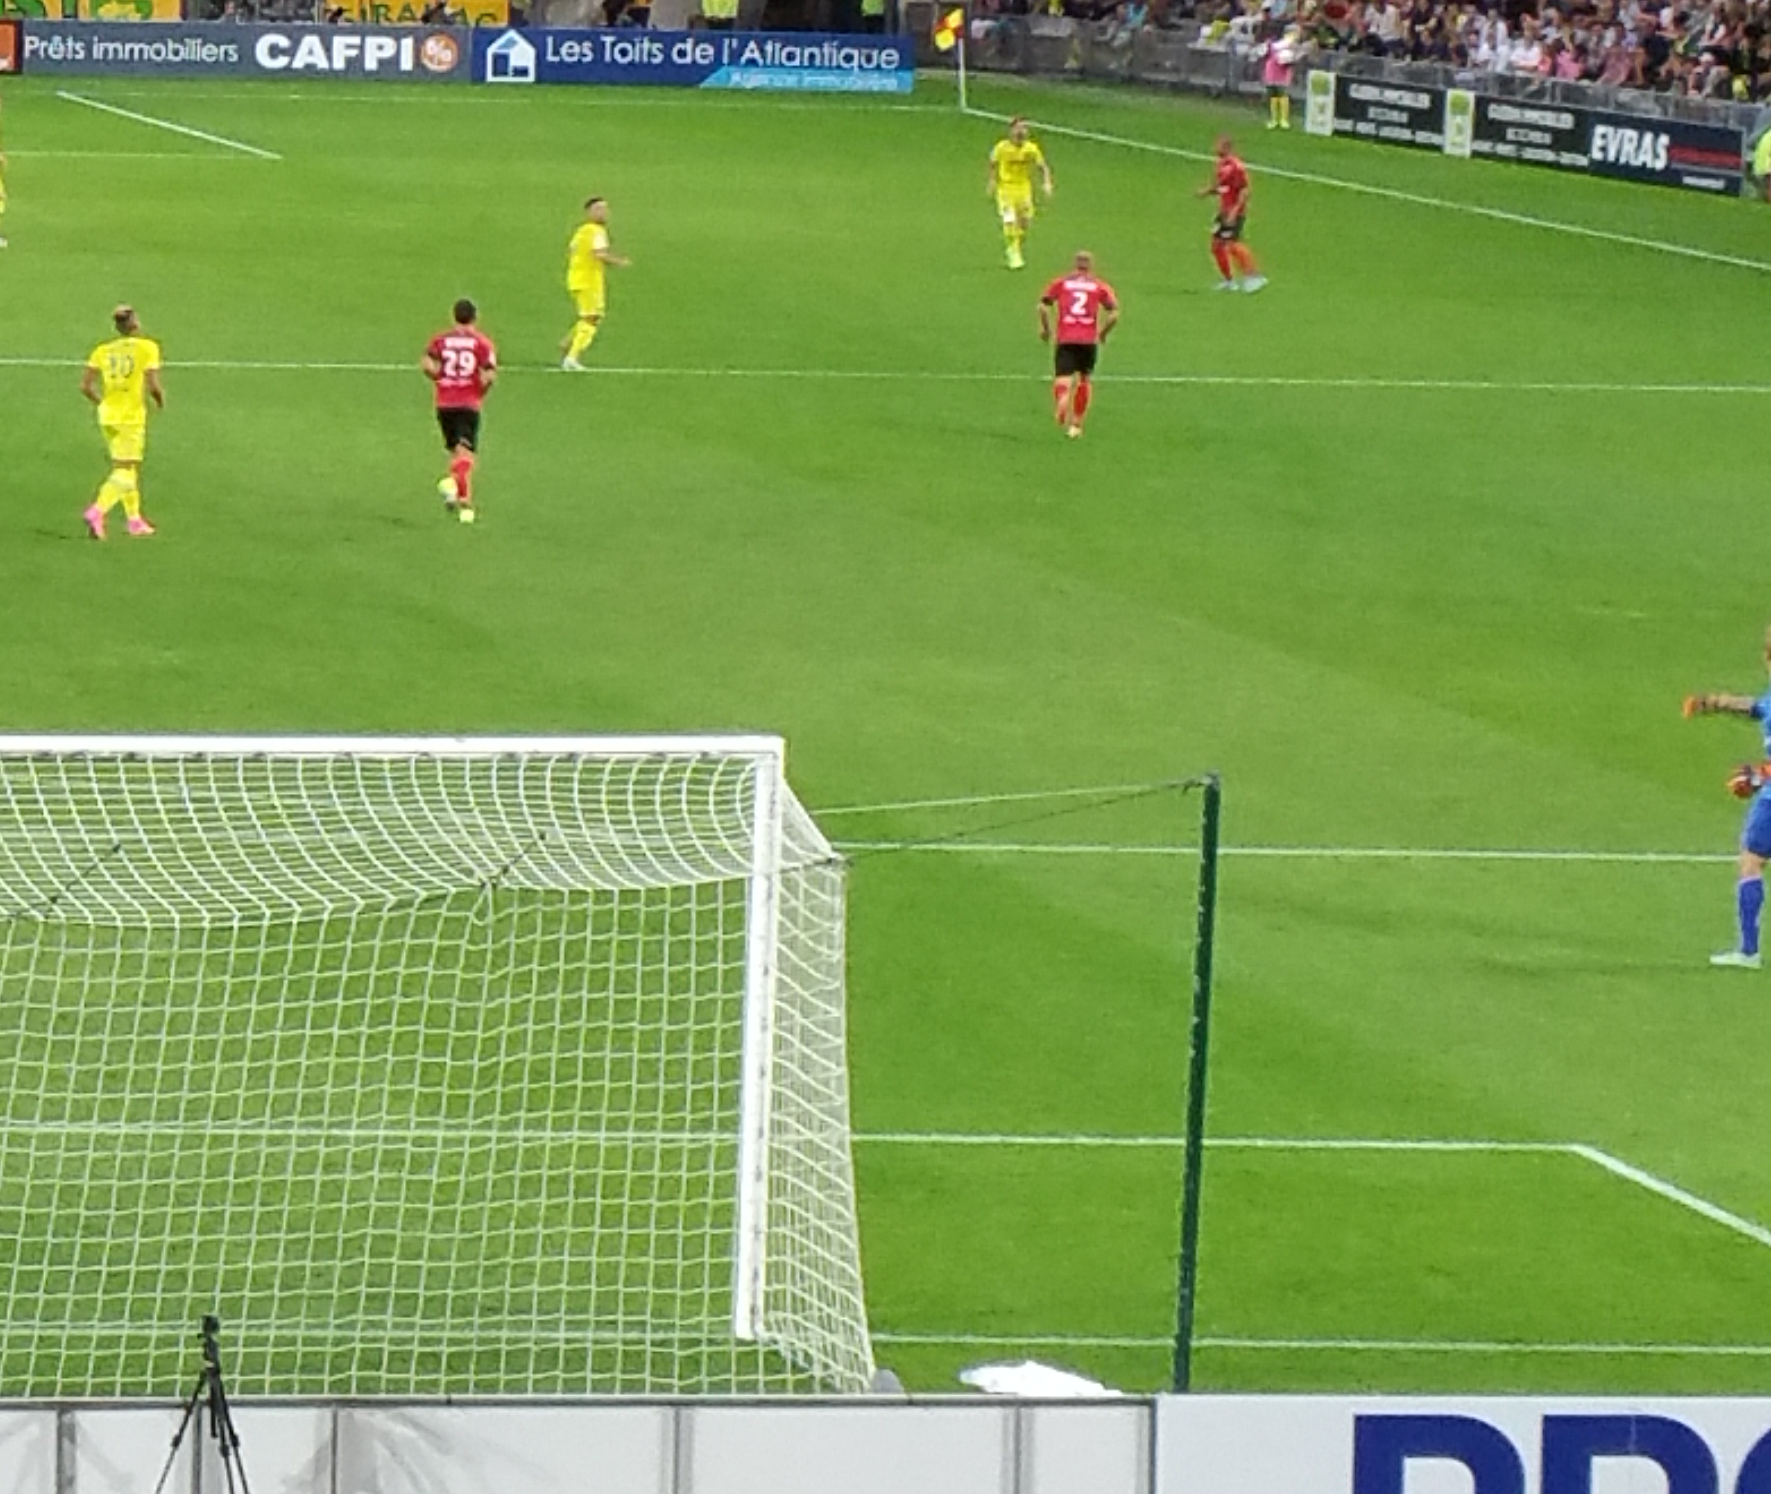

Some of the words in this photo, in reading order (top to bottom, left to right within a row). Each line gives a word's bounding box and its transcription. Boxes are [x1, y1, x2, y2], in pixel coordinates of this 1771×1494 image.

[92, 35, 239, 63] immobiliers
[255, 33, 414, 72] CAFPI
[545, 36, 593, 64] Les
[602, 34, 662, 65] Toits
[670, 37, 714, 65] de
[1591, 123, 1671, 172] EVRAS
[1069, 291, 1088, 315] 2
[441, 349, 477, 378] 29
